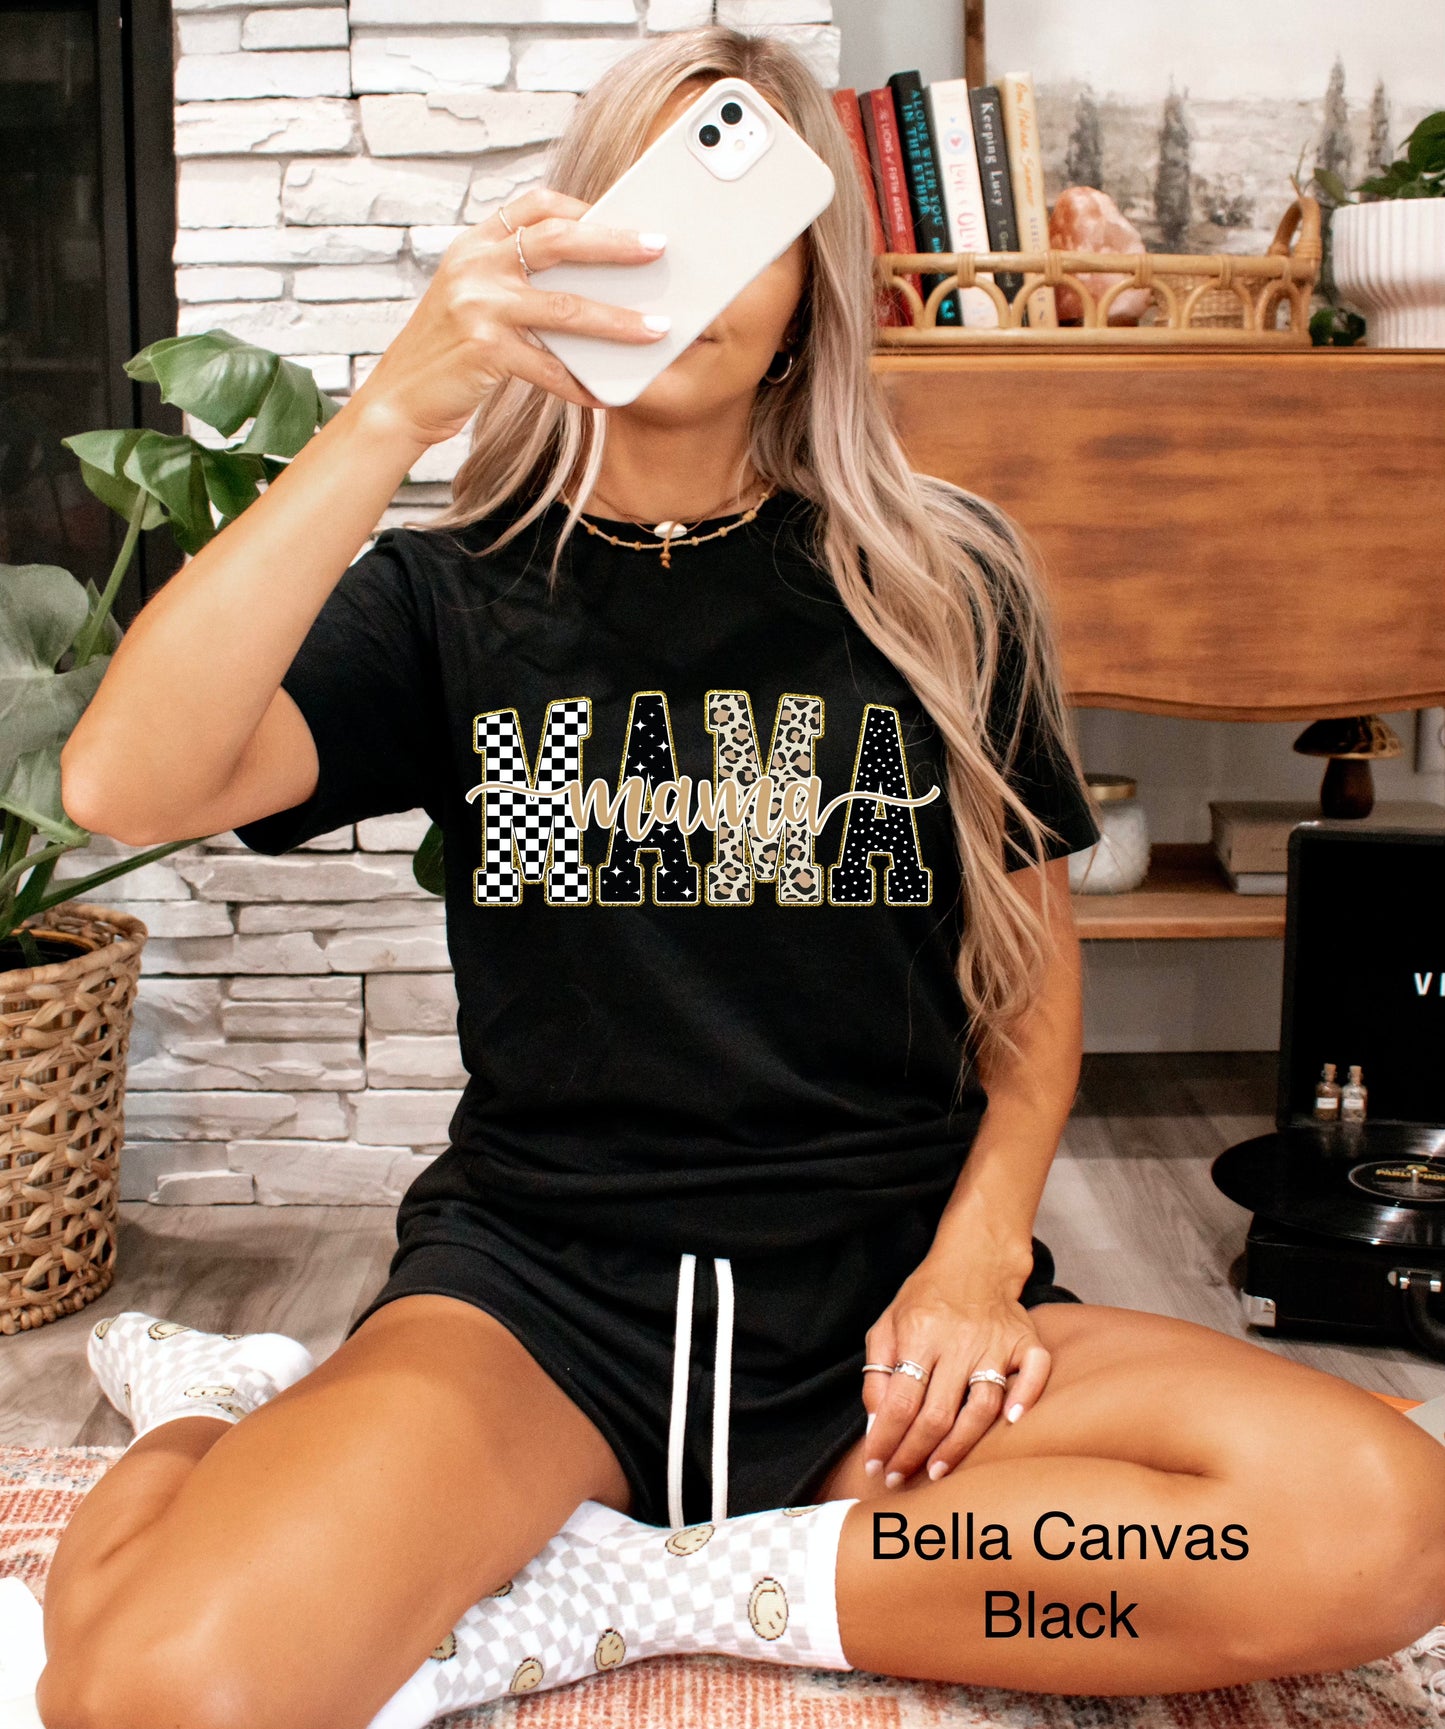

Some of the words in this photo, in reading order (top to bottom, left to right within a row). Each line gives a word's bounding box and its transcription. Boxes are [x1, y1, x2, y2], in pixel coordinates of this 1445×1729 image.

[902, 104, 915, 122] IN
[882, 123, 894, 154] LIONS
[906, 127, 920, 159] THE
[911, 89, 929, 140] ALONE
[922, 147, 937, 190] WITH
[930, 195, 944, 226] YOU
[981, 102, 998, 165] Keeping
[990, 170, 1003, 206] Lucy
[888, 166, 900, 194] FIFTH
[912, 164, 930, 215] ETHER
[893, 196, 906, 233] AVENUE
[466, 776, 940, 841] mama
[473, 690, 933, 906] MAMA
